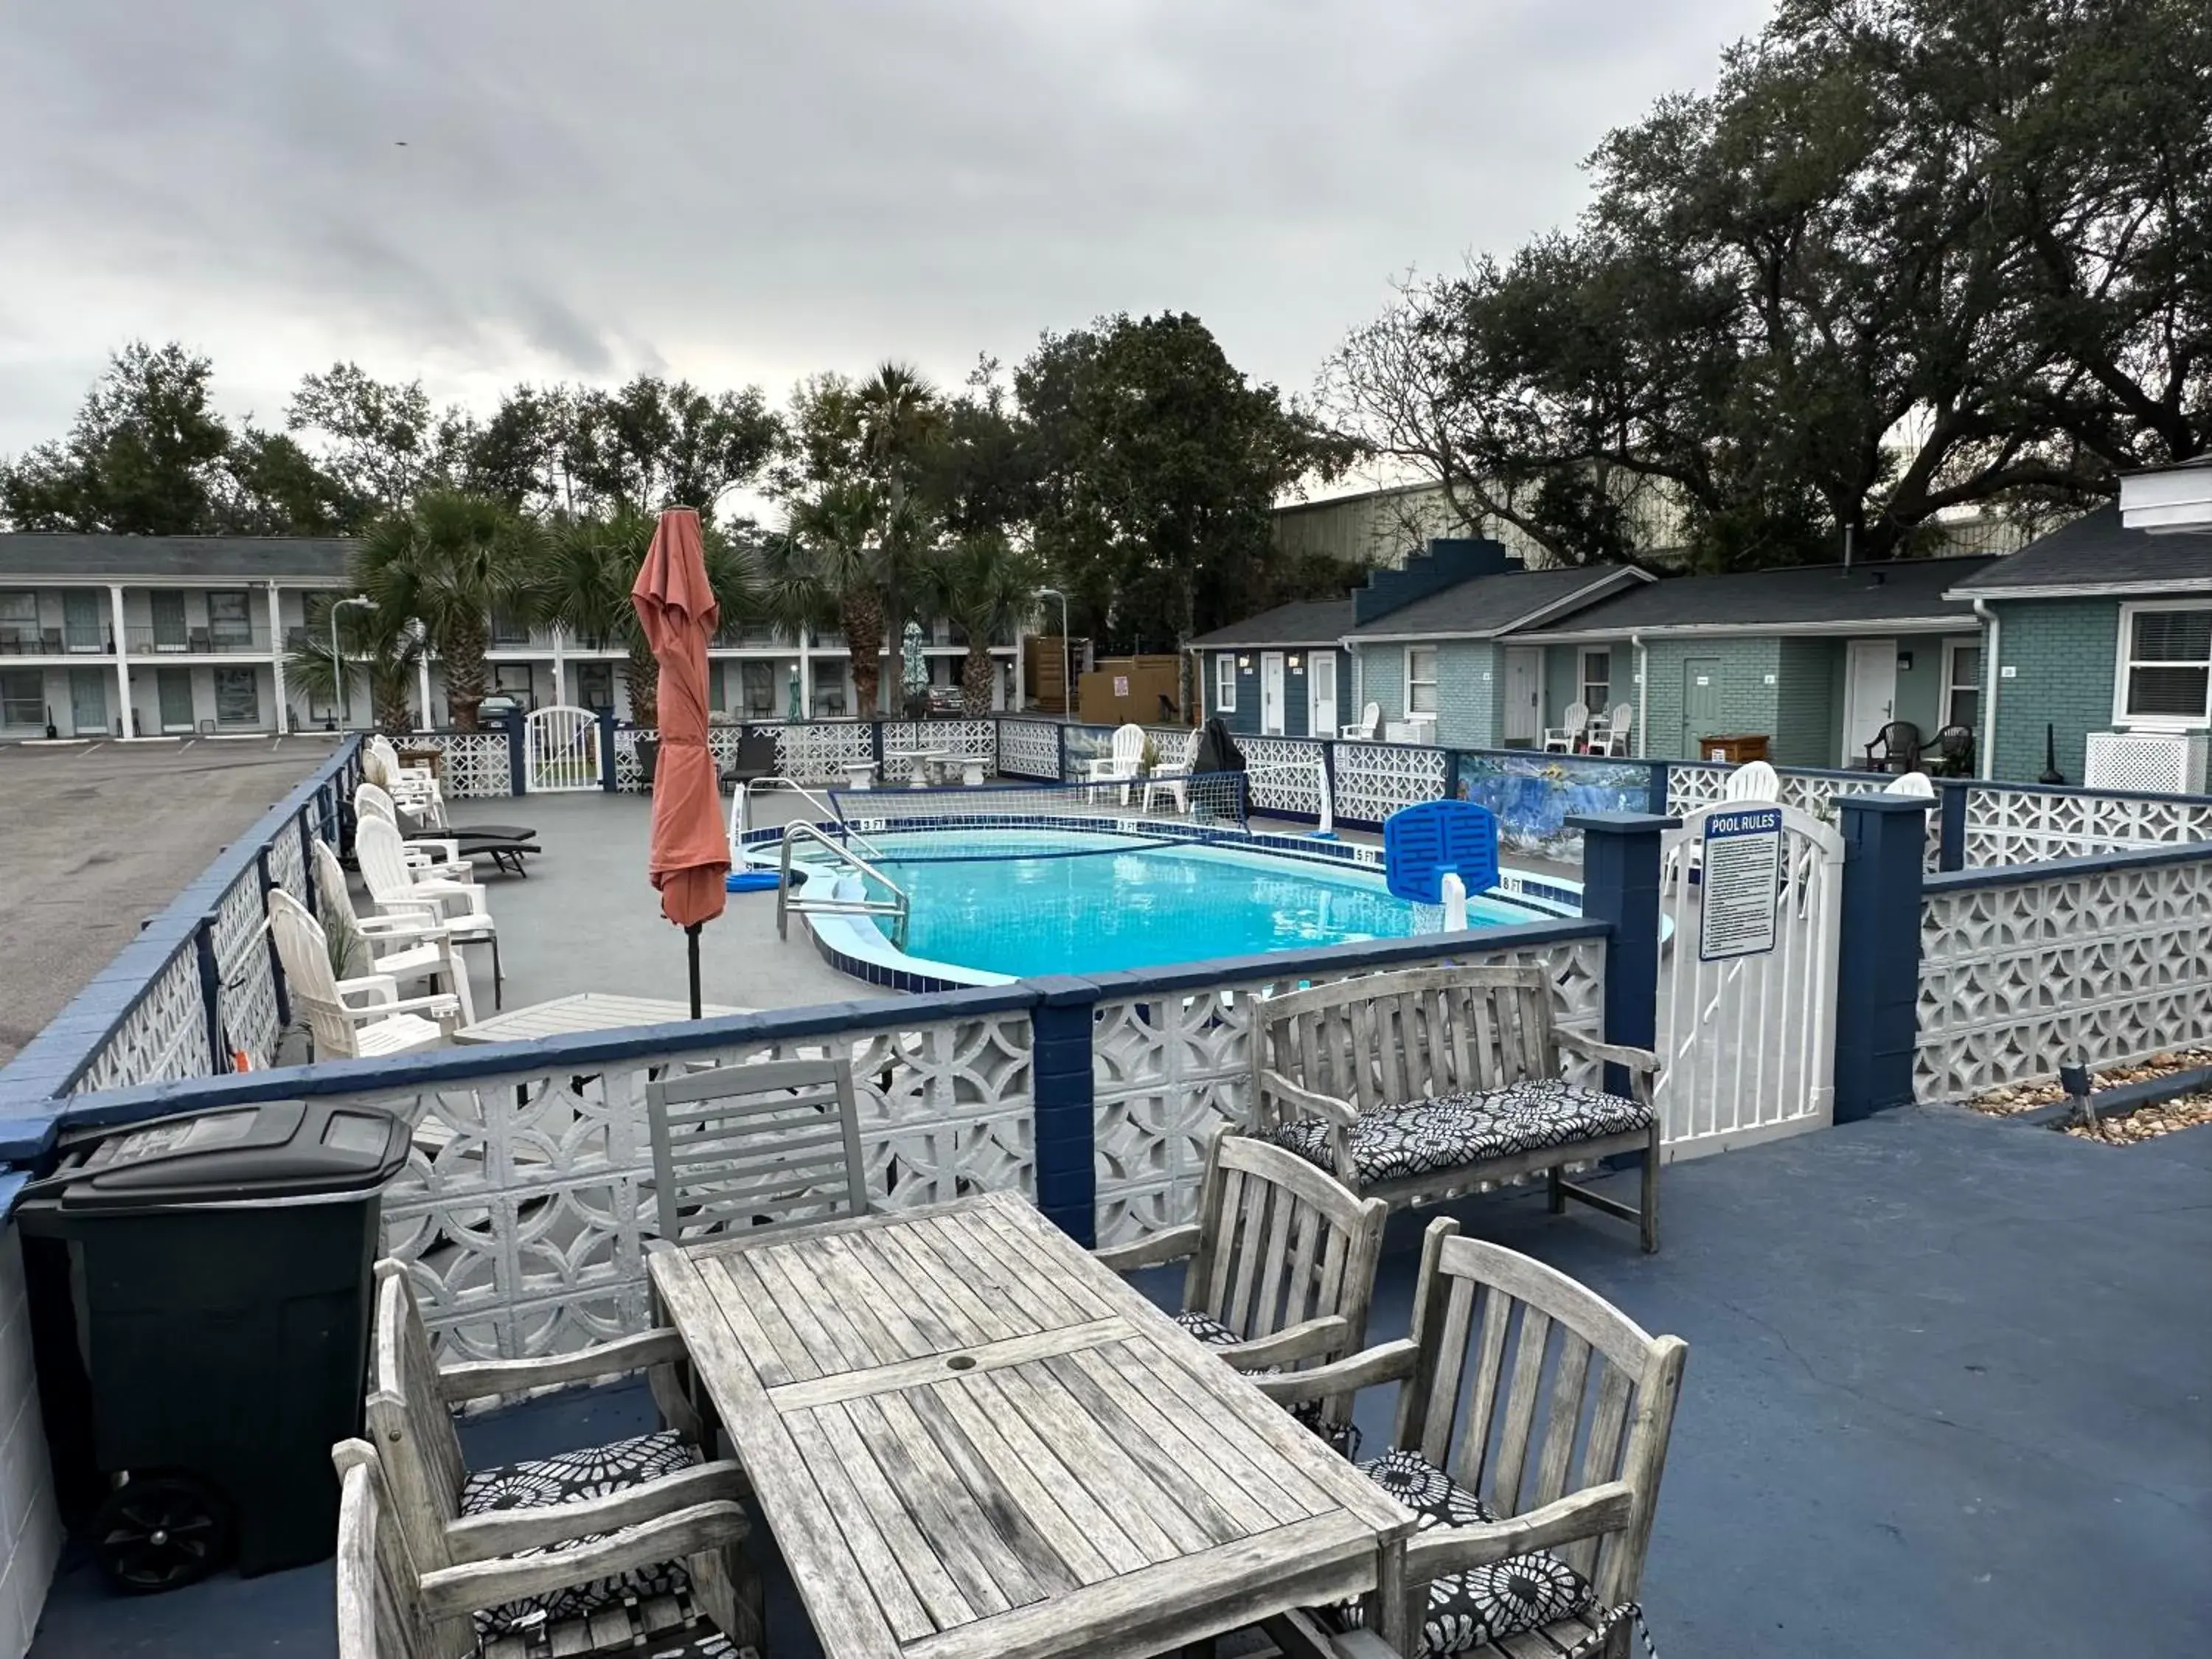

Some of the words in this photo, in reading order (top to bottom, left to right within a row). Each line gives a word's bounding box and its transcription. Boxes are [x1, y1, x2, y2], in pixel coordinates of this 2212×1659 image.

[863, 820, 870, 830] 3
[873, 819, 883, 830] FT
[1711, 816, 1740, 833] POOL
[1742, 813, 1775, 830] RULES
[1365, 850, 1374, 862] FT
[1511, 878, 1521, 893] FT
